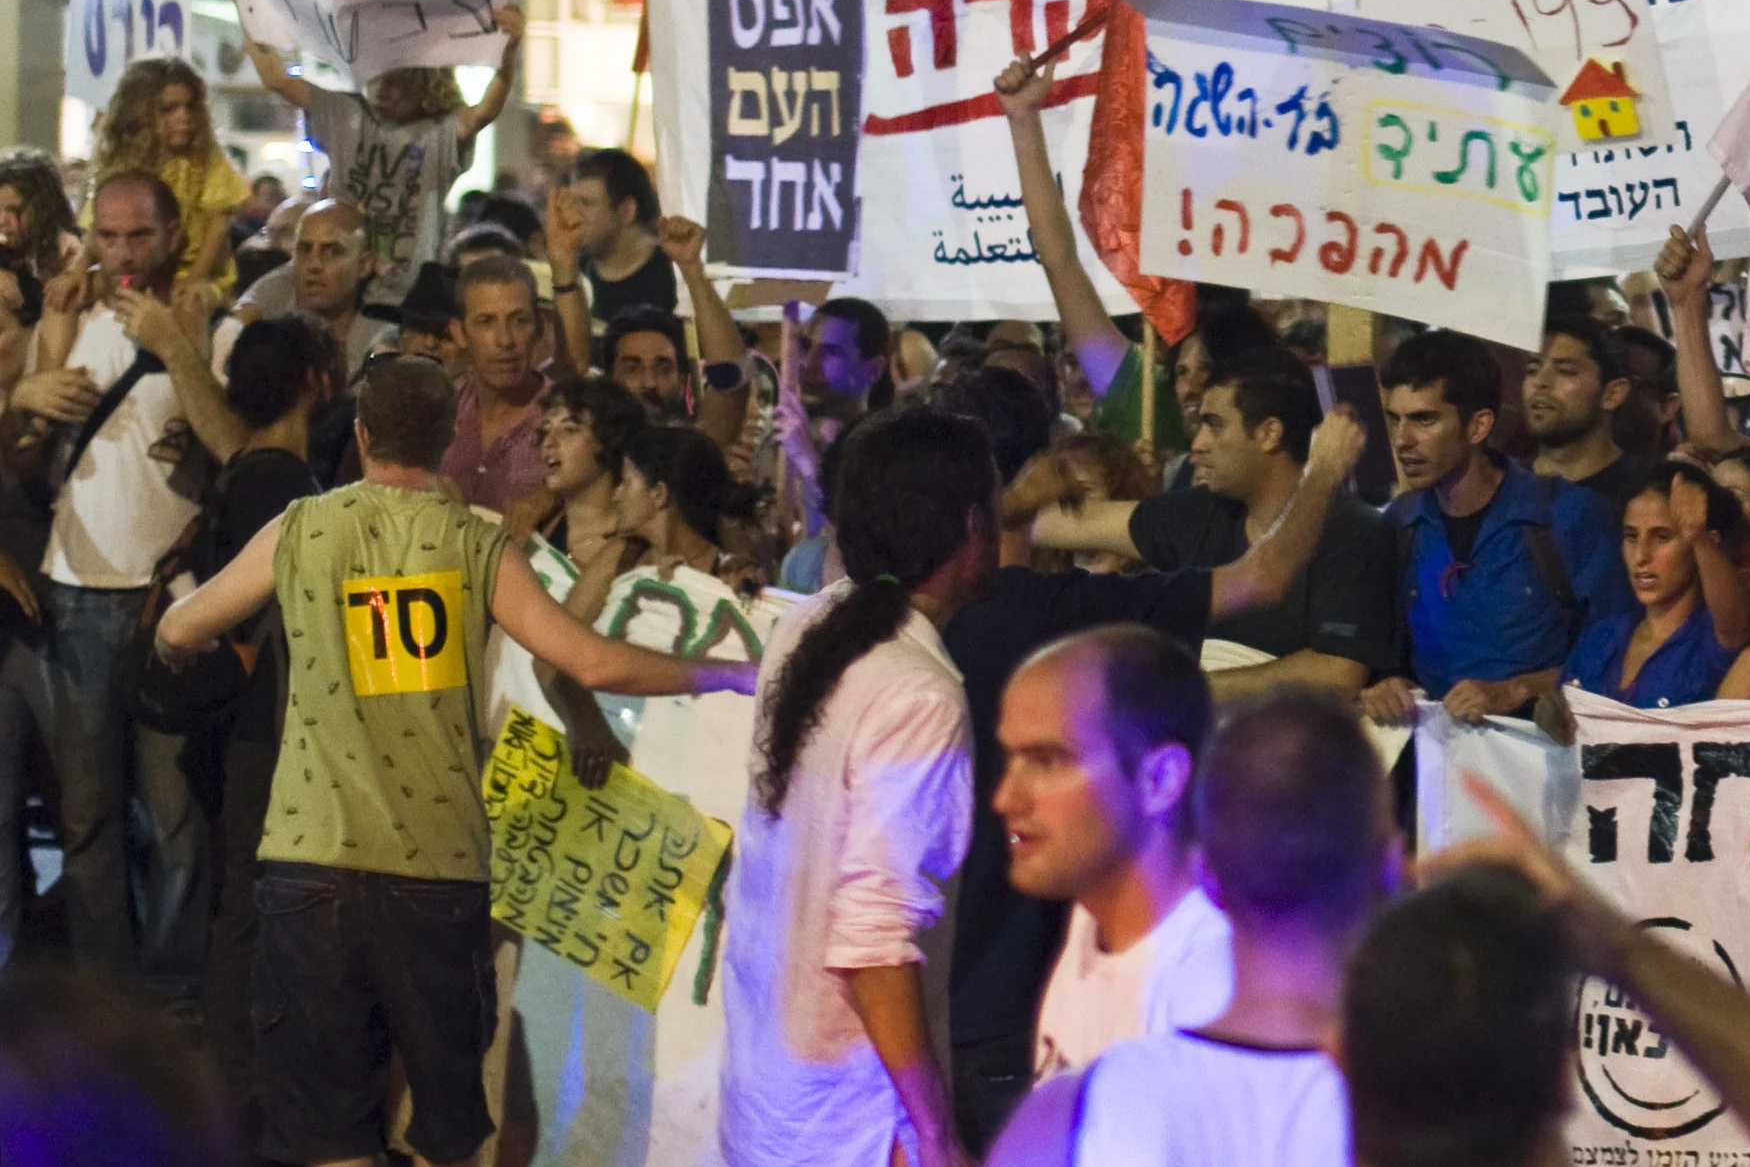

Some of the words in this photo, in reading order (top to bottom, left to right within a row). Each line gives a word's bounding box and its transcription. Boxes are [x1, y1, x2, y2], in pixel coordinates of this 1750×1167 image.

[727, 66, 841, 147] העם
[725, 154, 843, 232] אחד
[1377, 113, 1547, 203] עתיד
[1558, 177, 1681, 220] העובד
[1176, 186, 1470, 291] מהפכה!
